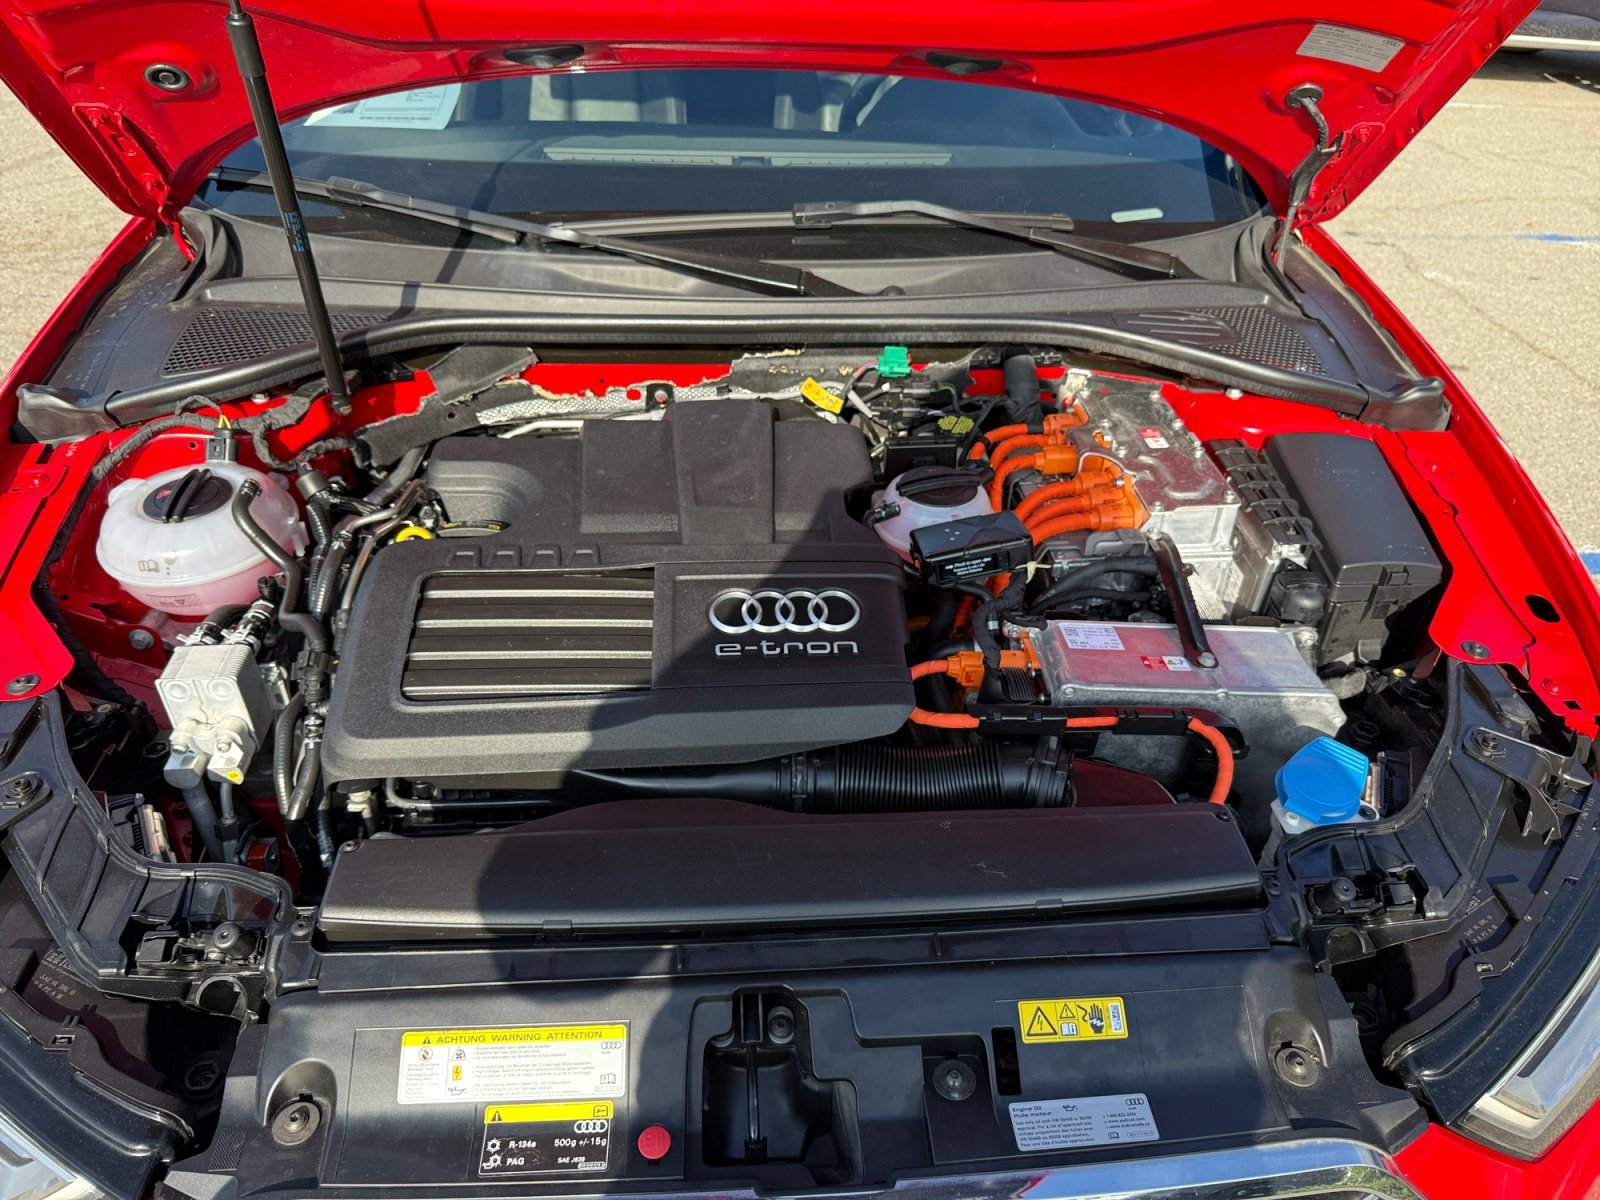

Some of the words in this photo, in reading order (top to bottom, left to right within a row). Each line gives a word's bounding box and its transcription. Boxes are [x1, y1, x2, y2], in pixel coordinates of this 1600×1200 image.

[714, 640, 858, 656] e-tron
[435, 1034, 486, 1044] ACHTUNG
[491, 1032, 541, 1042] WARNING
[546, 1030, 603, 1040] ATTENTION
[508, 1140, 537, 1149] R-134a
[554, 1138, 577, 1148] 500g
[590, 1136, 607, 1147] 15g
[506, 1157, 525, 1166] PAG
